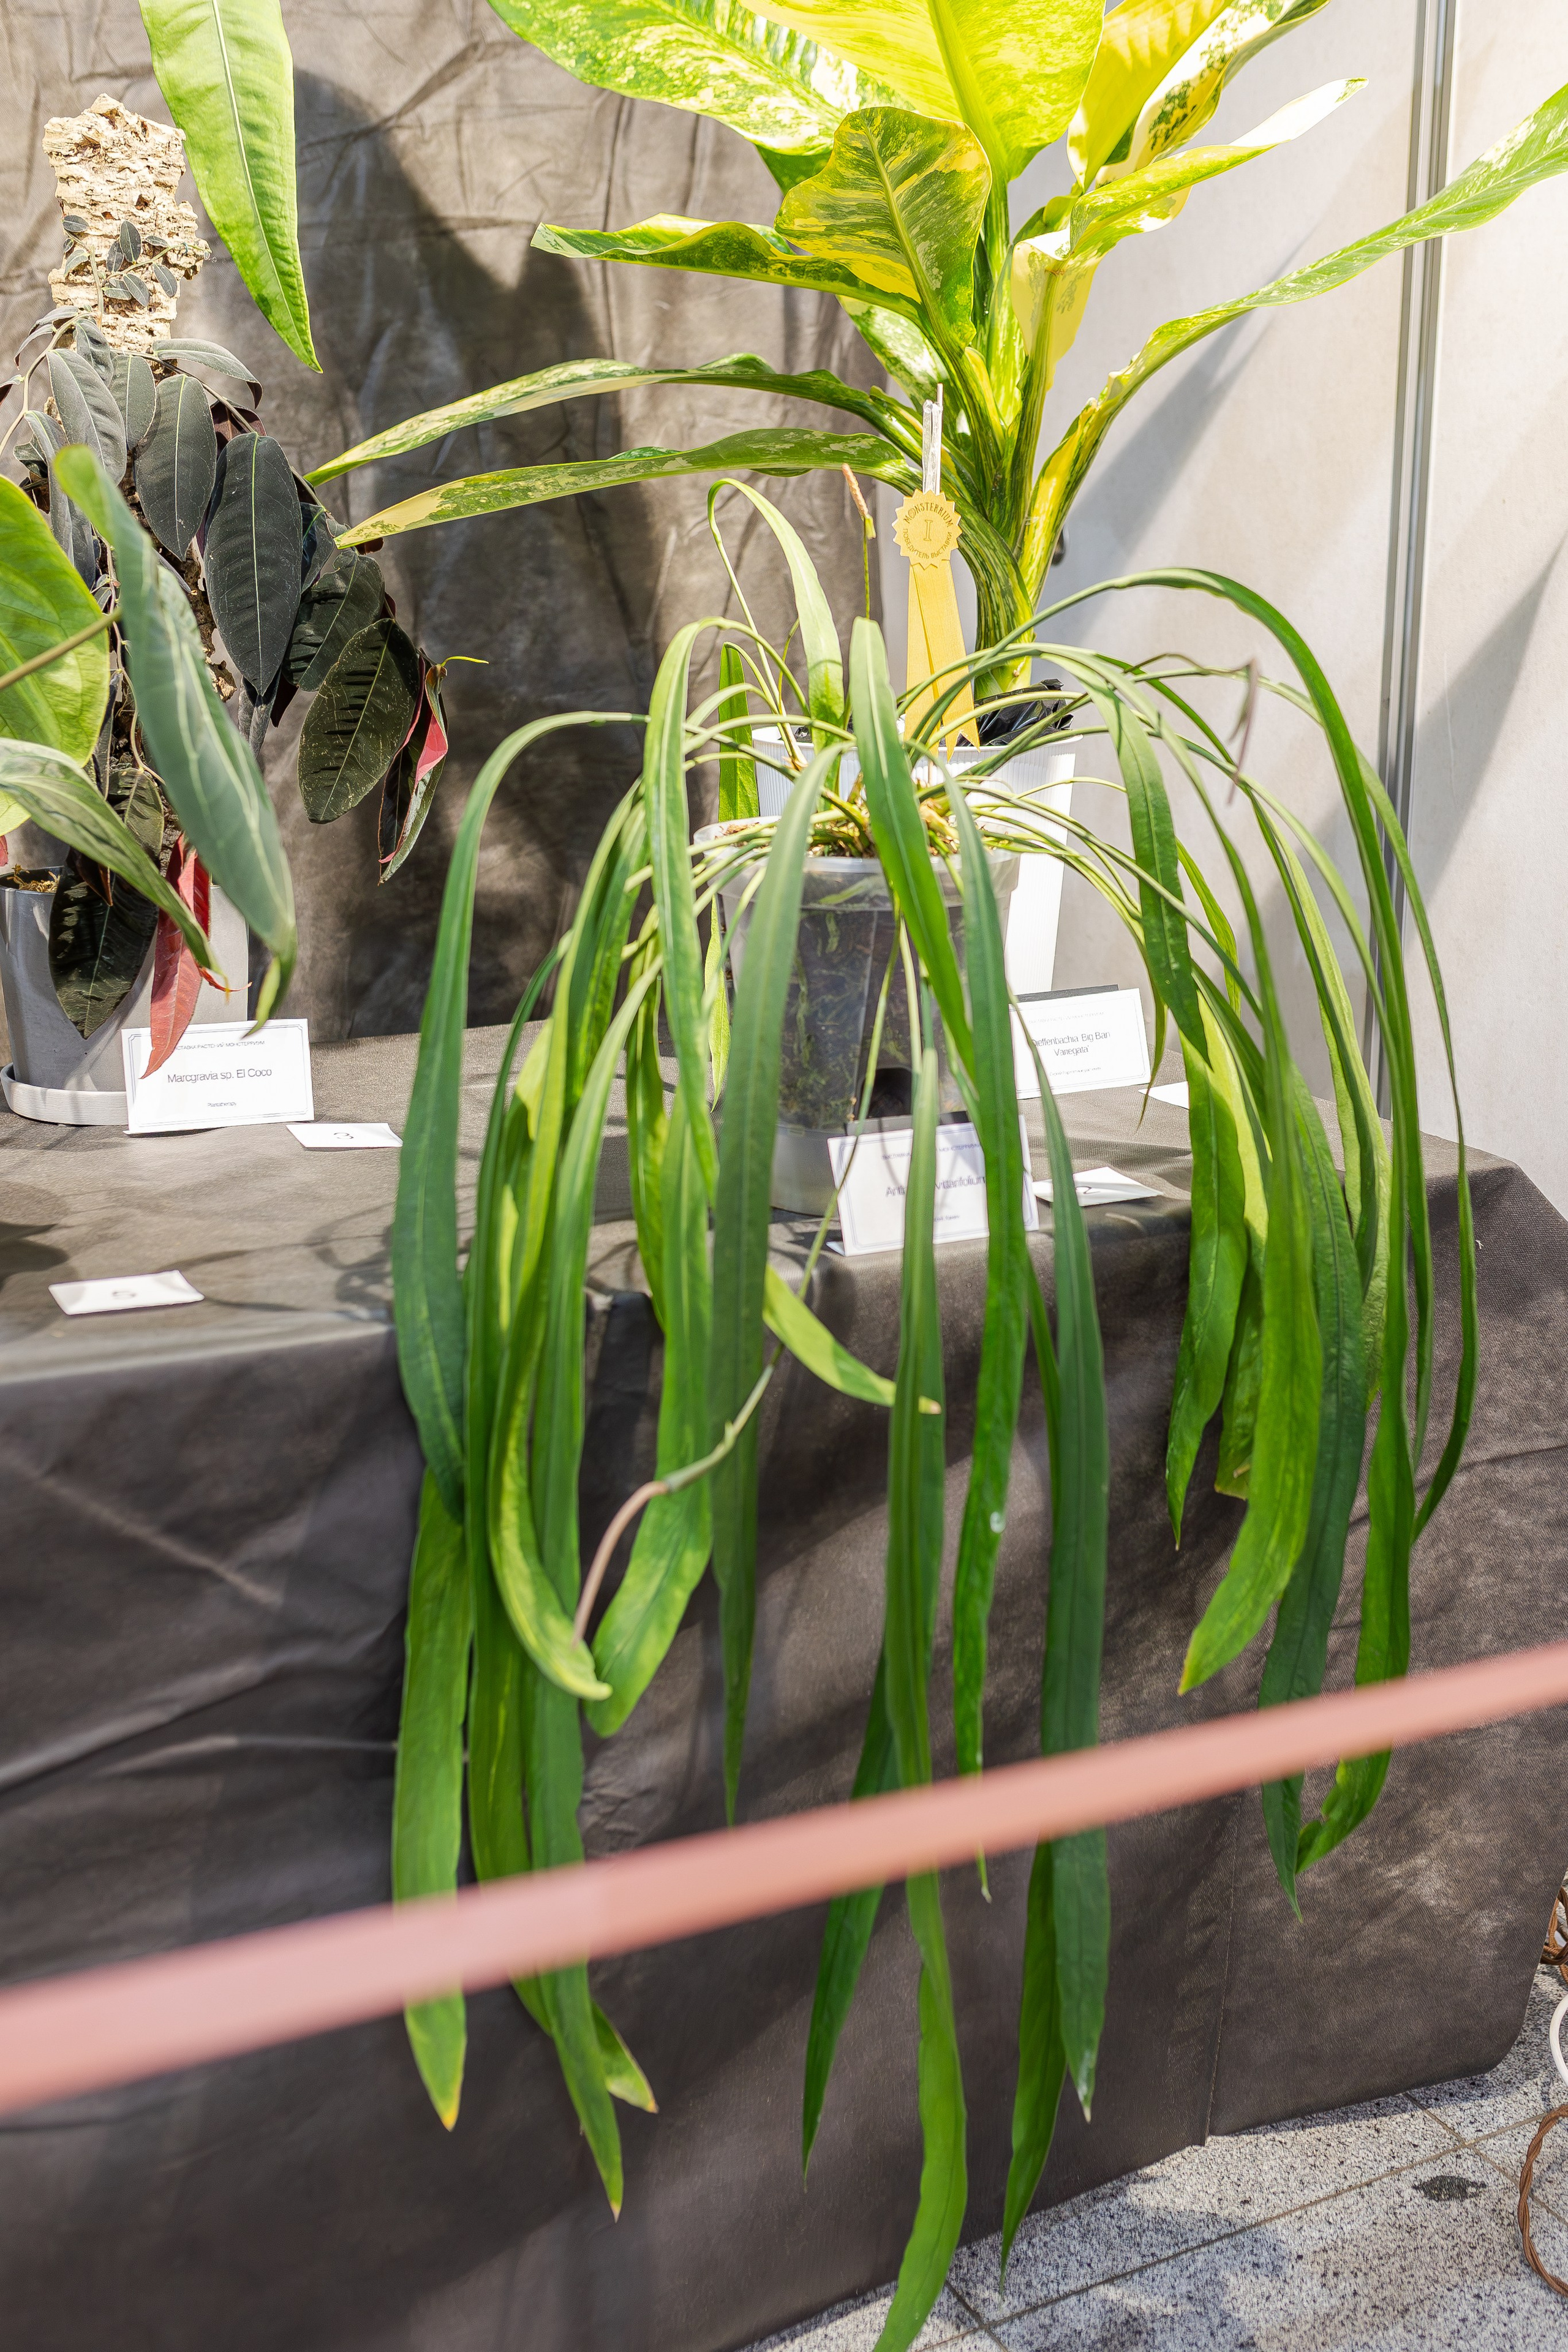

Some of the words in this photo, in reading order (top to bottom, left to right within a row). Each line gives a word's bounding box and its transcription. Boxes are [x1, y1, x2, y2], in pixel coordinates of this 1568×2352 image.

[903, 502, 954, 527] MONSTERRIUM
[903, 529, 930, 559] ПОБЕДИТЕЛЬ
[930, 532, 952, 559] ВЫСТАВКИ
[1081, 1033, 1094, 1042] Big
[167, 1071, 218, 1084] Marcgravia
[220, 1071, 234, 1081] sp.
[236, 1069, 245, 1078] El
[247, 1068, 272, 1077] Coco
